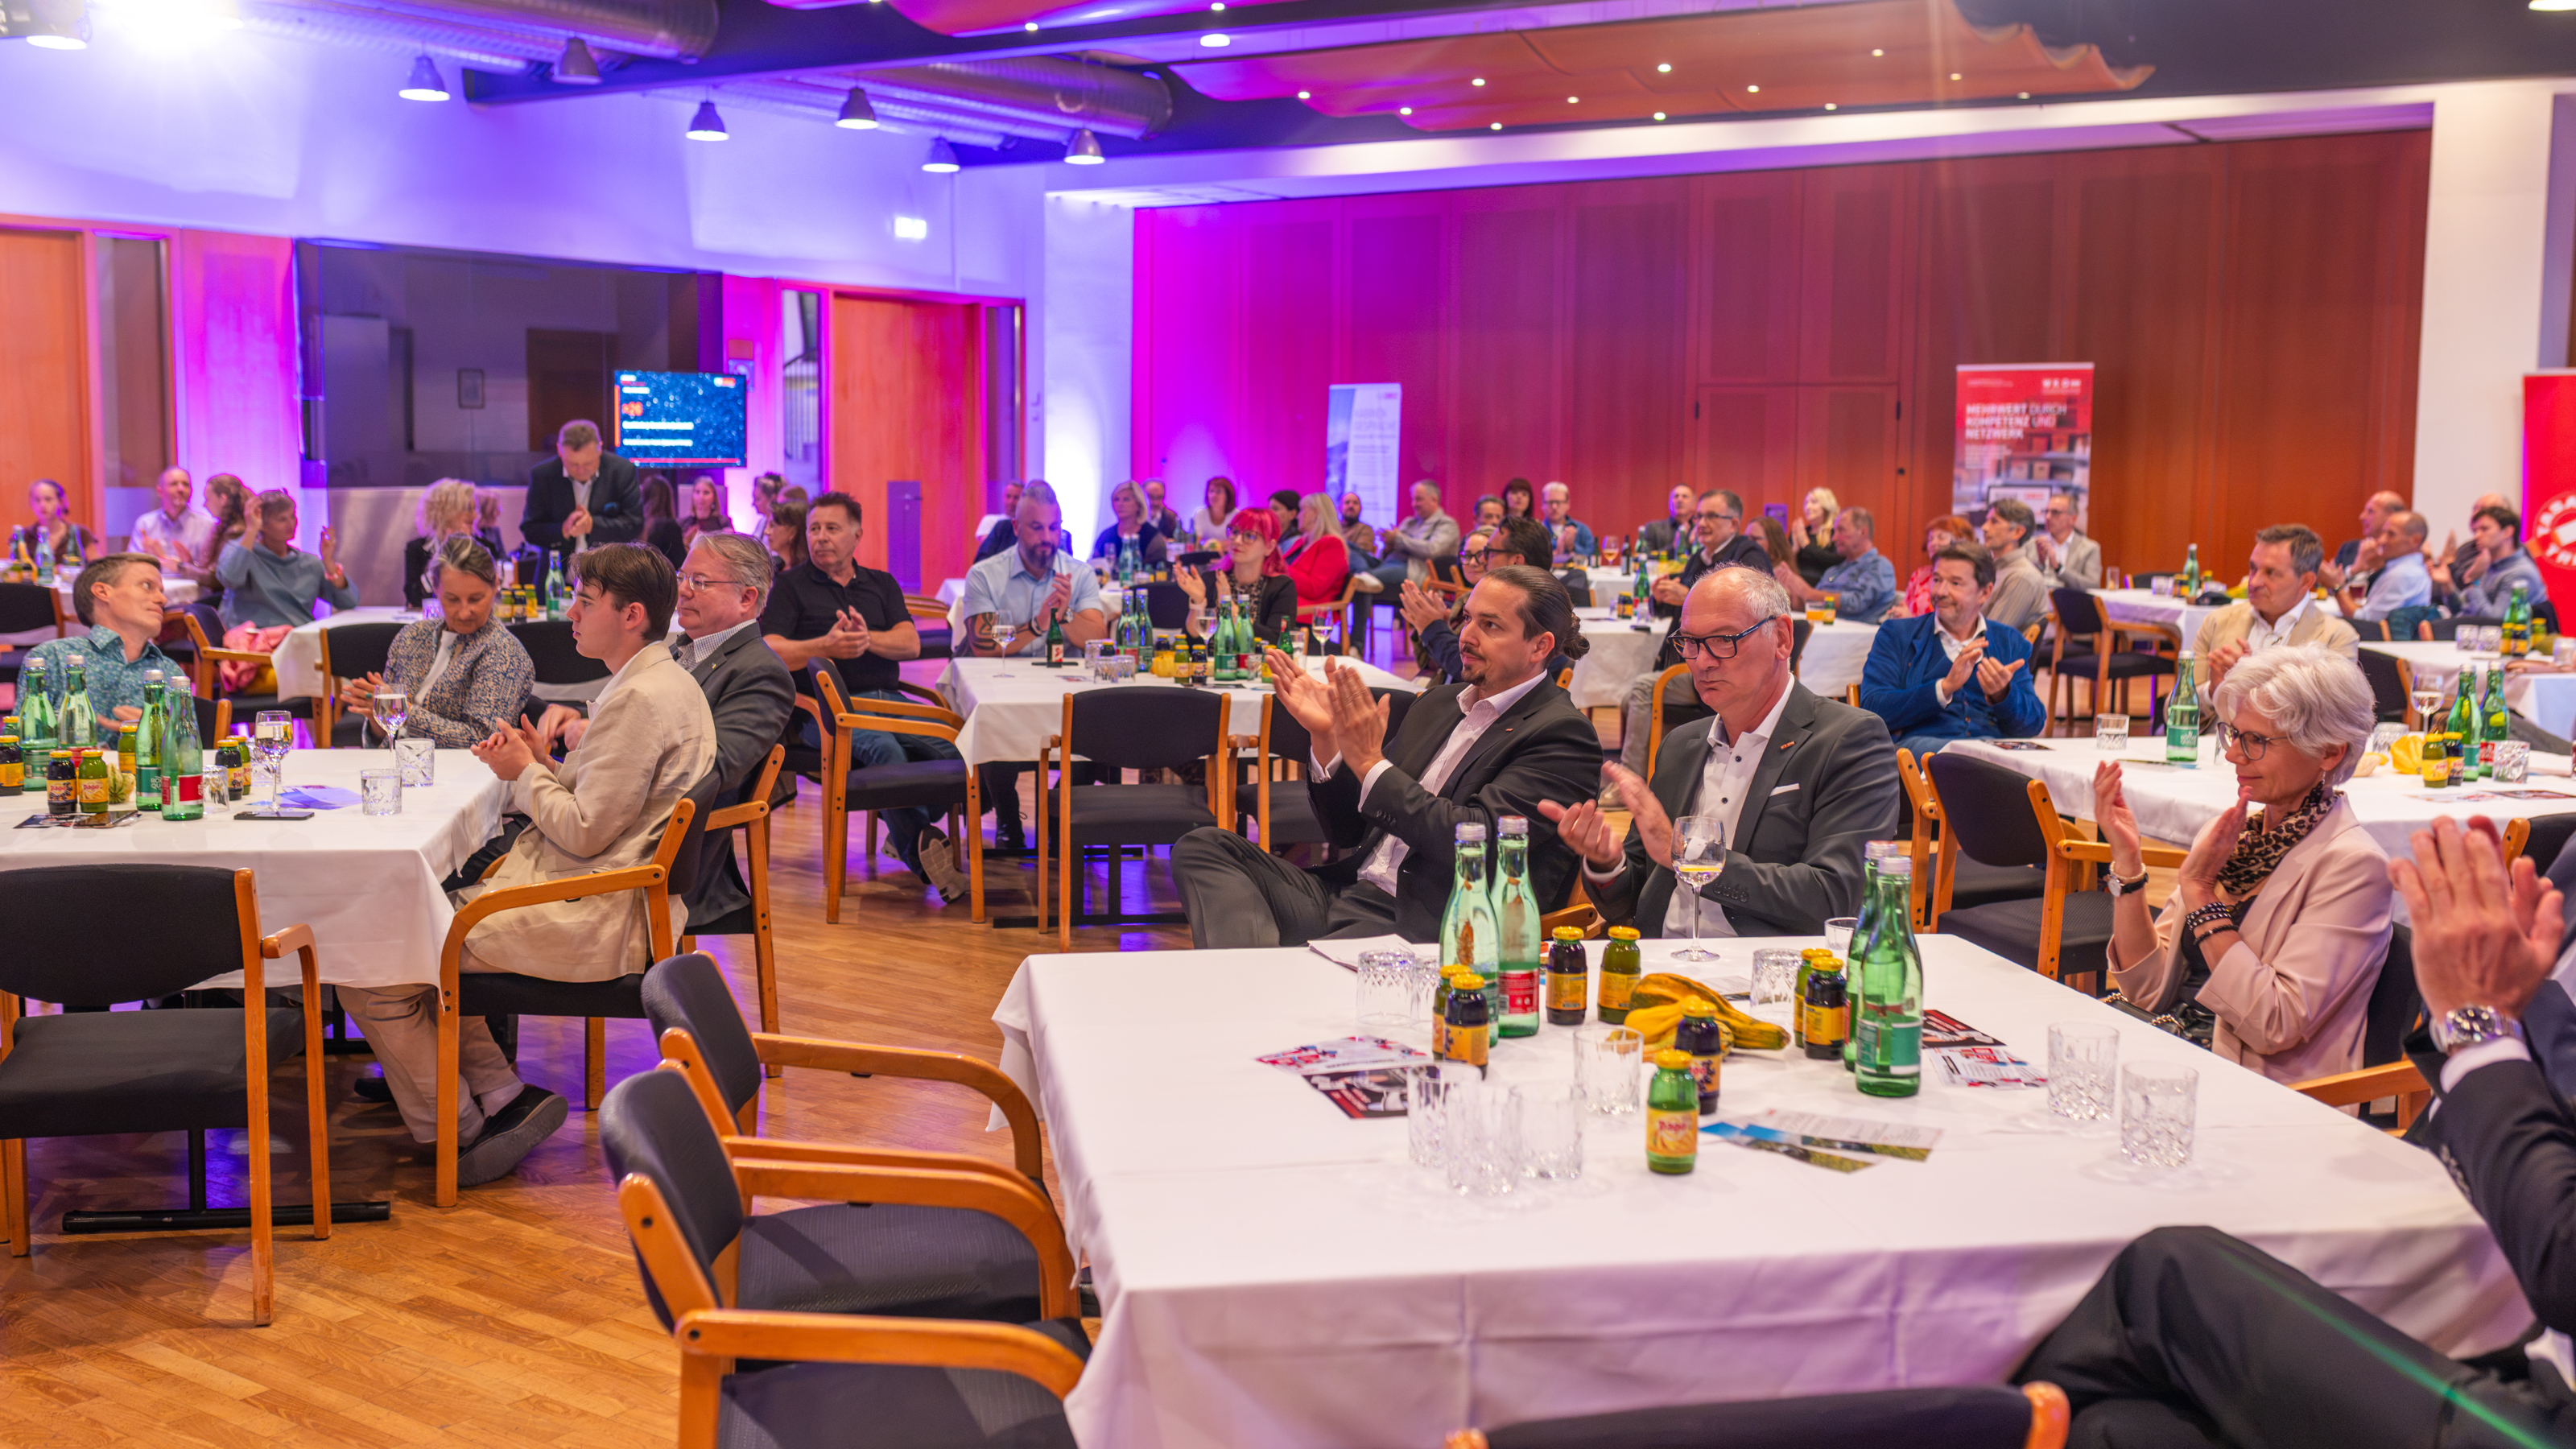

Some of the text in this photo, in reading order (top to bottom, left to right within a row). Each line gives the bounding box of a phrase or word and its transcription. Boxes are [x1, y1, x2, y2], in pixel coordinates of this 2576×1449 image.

[1966, 402, 2067, 415] MEHRWERT DURCH
[1965, 415, 2057, 428] KOMPETENZ UND
[1965, 428, 2024, 440] NETZWERK
